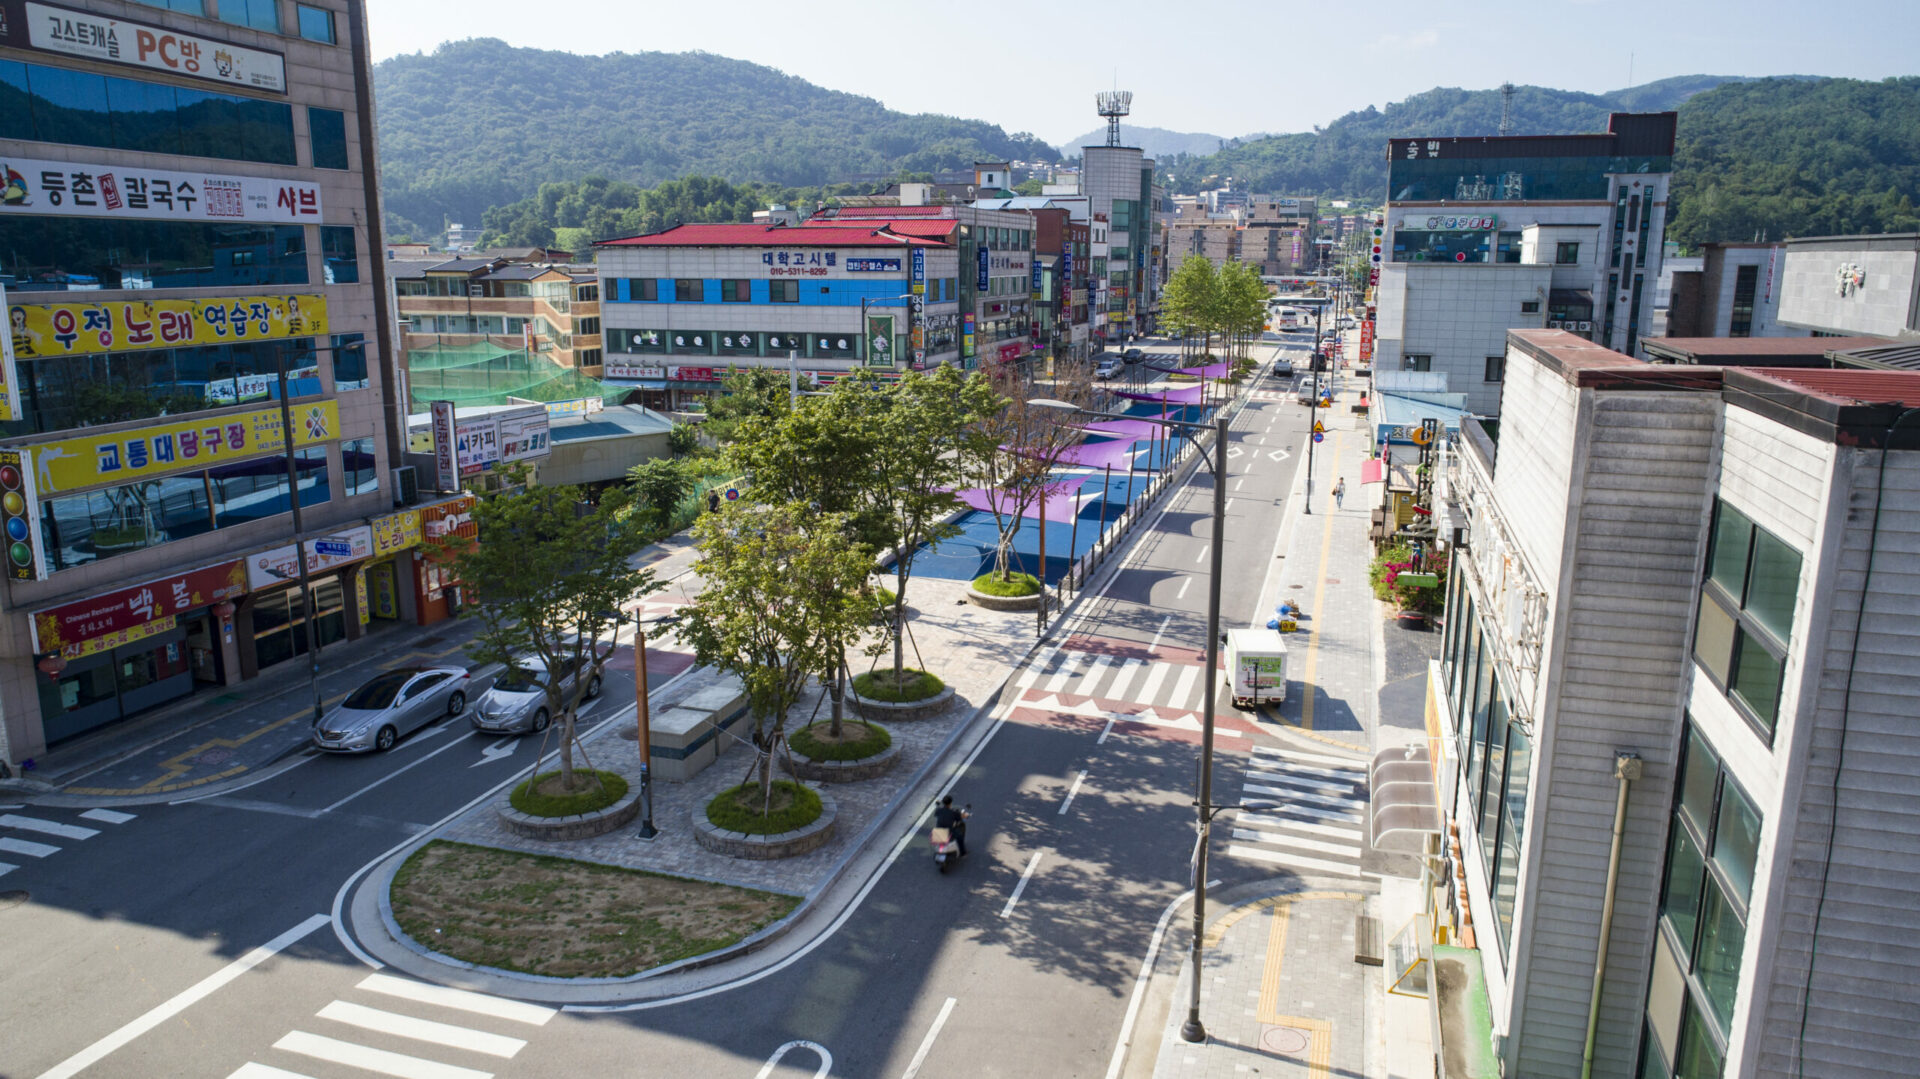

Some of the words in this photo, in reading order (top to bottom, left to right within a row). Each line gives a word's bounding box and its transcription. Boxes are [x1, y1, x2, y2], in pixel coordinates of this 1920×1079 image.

[48, 15, 120, 58] 고스트캐슬
[41, 171, 97, 207] 등촌
[124, 177, 198, 212] 칼국수
[278, 186, 318, 217] 샤브
[762, 252, 837, 267] 대학고시텔
[53, 306, 113, 349] 우정
[124, 303, 194, 344] 노래
[203, 301, 271, 337] 연습장
[379, 532, 405, 550] 노래
[18, 569, 29, 579] 2F
[65, 610, 90, 625] Chinese
[91, 602, 125, 617] Restaurant
